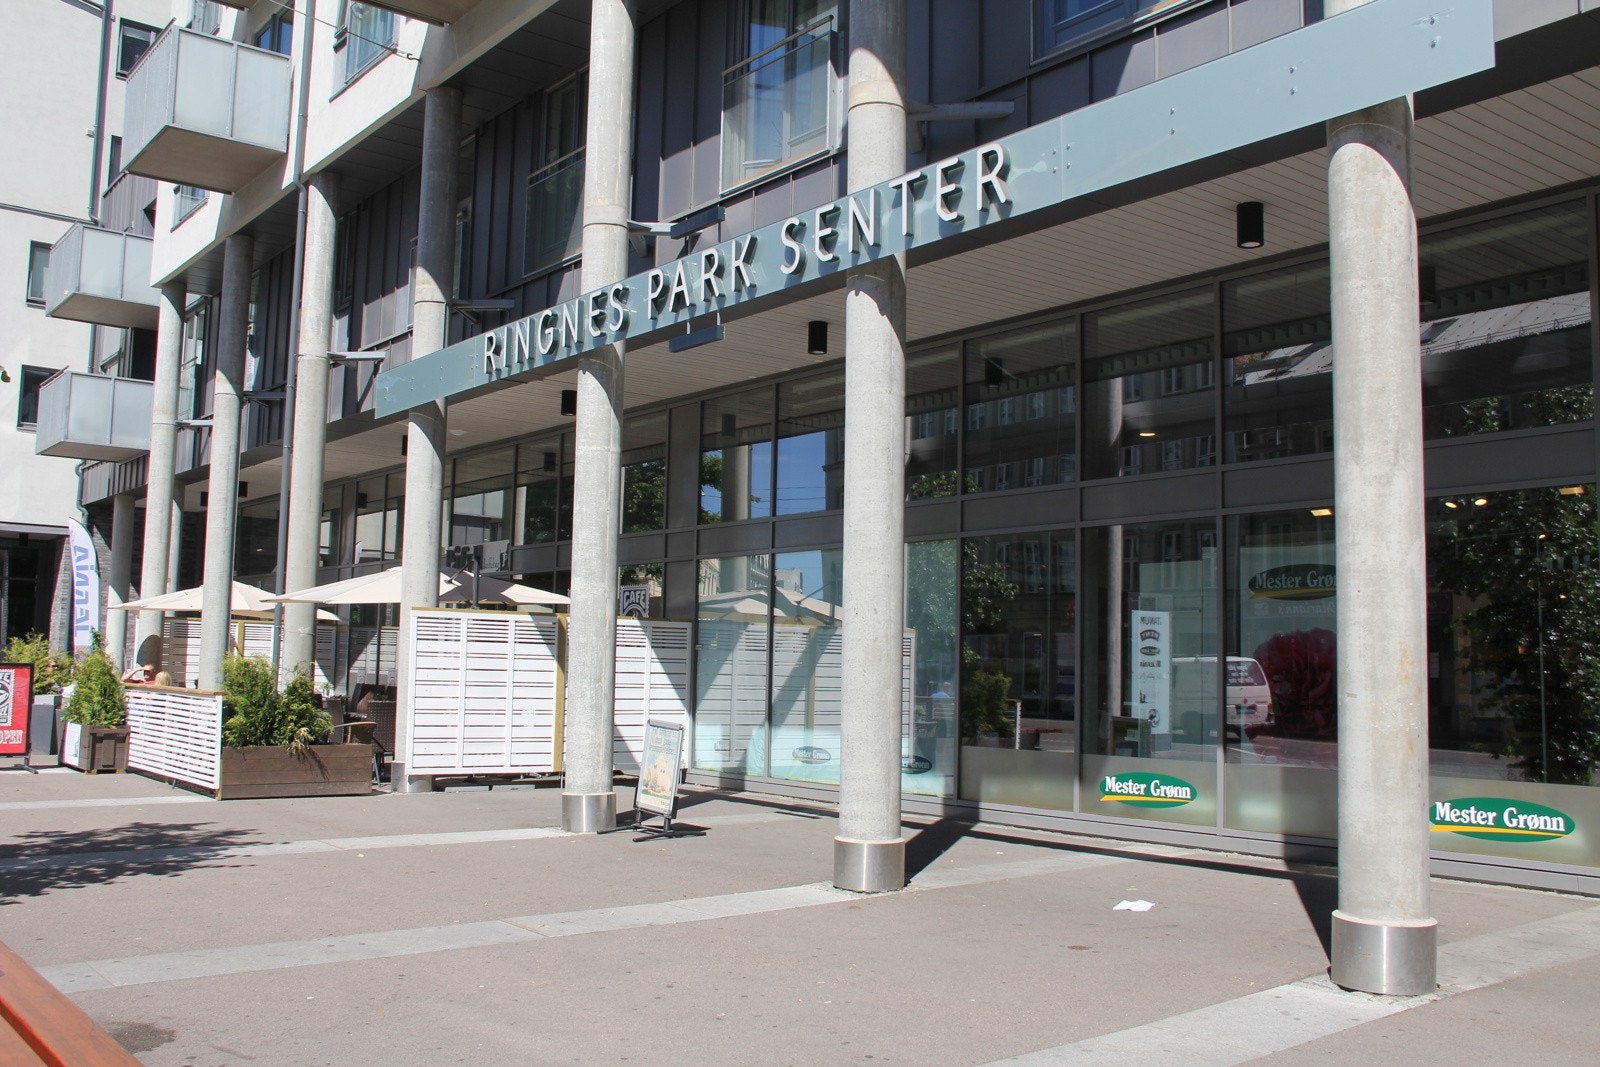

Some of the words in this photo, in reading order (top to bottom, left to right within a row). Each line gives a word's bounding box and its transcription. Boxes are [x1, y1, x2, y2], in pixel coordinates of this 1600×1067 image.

[484, 283, 627, 374] RINGNES
[647, 234, 755, 320] PARK
[780, 143, 1010, 276] SENTER
[1255, 572, 1301, 589] Mester
[1307, 570, 1336, 588] Grø
[623, 590, 646, 610] CAFE
[1105, 775, 1147, 795] Mester
[1150, 779, 1191, 799] Grønn
[1435, 801, 1496, 826] Mester
[1503, 807, 1566, 832] Grønn
